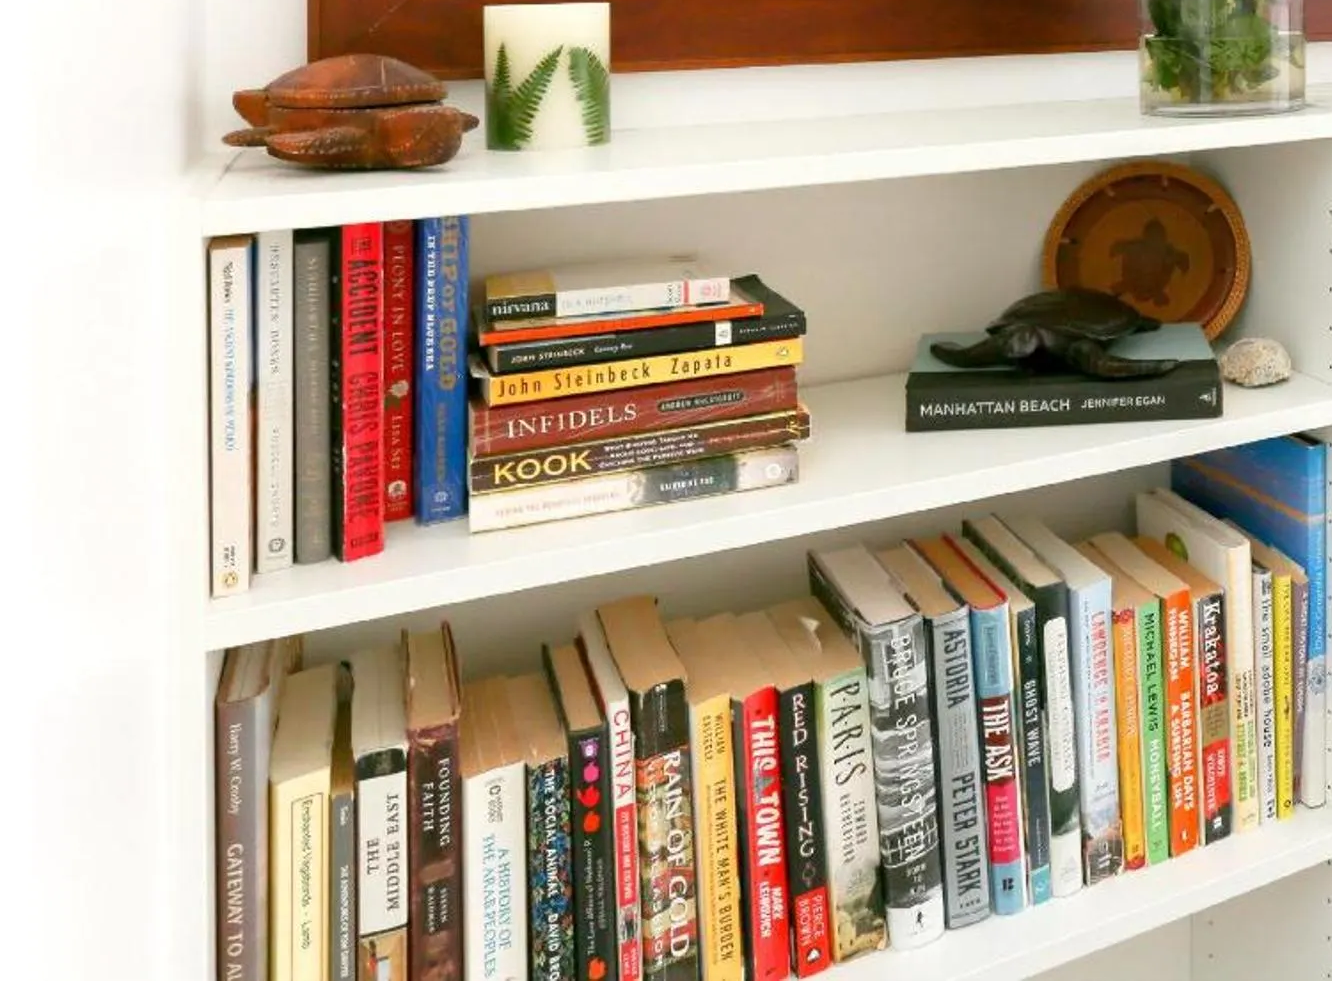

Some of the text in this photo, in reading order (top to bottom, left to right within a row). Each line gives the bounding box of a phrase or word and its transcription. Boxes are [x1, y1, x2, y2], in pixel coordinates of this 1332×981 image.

[439, 218, 460, 287] SHIP
[391, 245, 405, 374] PEONY IN LOVE
[492, 298, 550, 317] nirvana
[439, 317, 461, 392] GOLD
[497, 353, 733, 398] John Steinbeck Zapata
[510, 353, 537, 364] JOHN
[538, 347, 586, 361] STEINBECK
[346, 259, 379, 524] ACCIDENT CHRIS PAVONE
[506, 403, 639, 440] INFIDELS
[919, 399, 1070, 418] MANHATTAN BEACH
[1081, 396, 1166, 410] JENNIFER EGAN
[493, 450, 593, 485] KOOK
[1178, 608, 1190, 670] WILLIAM
[1261, 598, 1273, 623] the
[1261, 626, 1273, 659] small
[889, 633, 916, 710] BRUCE
[943, 629, 972, 708] ASTORIA
[1090, 610, 1109, 688] LAWRENCE
[1168, 607, 1179, 682] FINNEGAN
[1202, 599, 1222, 696] Krakatoa
[1262, 665, 1274, 704] adobe
[714, 712, 726, 755] WILLIAM
[981, 699, 1011, 739] THE
[1023, 679, 1042, 767] GHOST WAVE
[1094, 709, 1111, 763] ARABIA
[1143, 612, 1163, 832] MICHAEL LEWIS MONEYBALL
[1180, 691, 1196, 812] BARBARIAN DAYS
[1262, 709, 1275, 748] house
[227, 722, 244, 816] Harry W. Crosby
[613, 709, 633, 799] CHINA
[662, 750, 683, 820] RAIN
[792, 693, 816, 858] RED RISING
[984, 742, 1014, 782] ASK
[1170, 703, 1184, 808] A SURFING LIFE
[422, 781, 435, 832] FAITH
[438, 757, 451, 848] FOUNDING
[750, 715, 783, 866] THIS TOWN
[893, 715, 926, 865] SPRINGSTEEN
[952, 774, 982, 832] PETER
[366, 838, 380, 876] THE
[386, 794, 401, 912] MIDDLE EAST
[544, 769, 558, 899] THE SOCIAL ANIMAL
[665, 828, 685, 869] OF
[956, 835, 983, 897] STARK
[226, 843, 244, 925] GATEWAY
[498, 847, 513, 948] A HISTORY OF
[713, 776, 735, 961] THE WHITE MAN'S BURDEN
[301, 920, 313, 950] Lamb
[481, 834, 497, 977] THE ARAB PEOPLES
[546, 912, 559, 953] DAVID
[668, 876, 690, 958] GOLD
[770, 887, 784, 920] MARK
[799, 899, 812, 946] BROWN
[811, 894, 825, 939] PIERCE
[227, 931, 244, 958] TO
